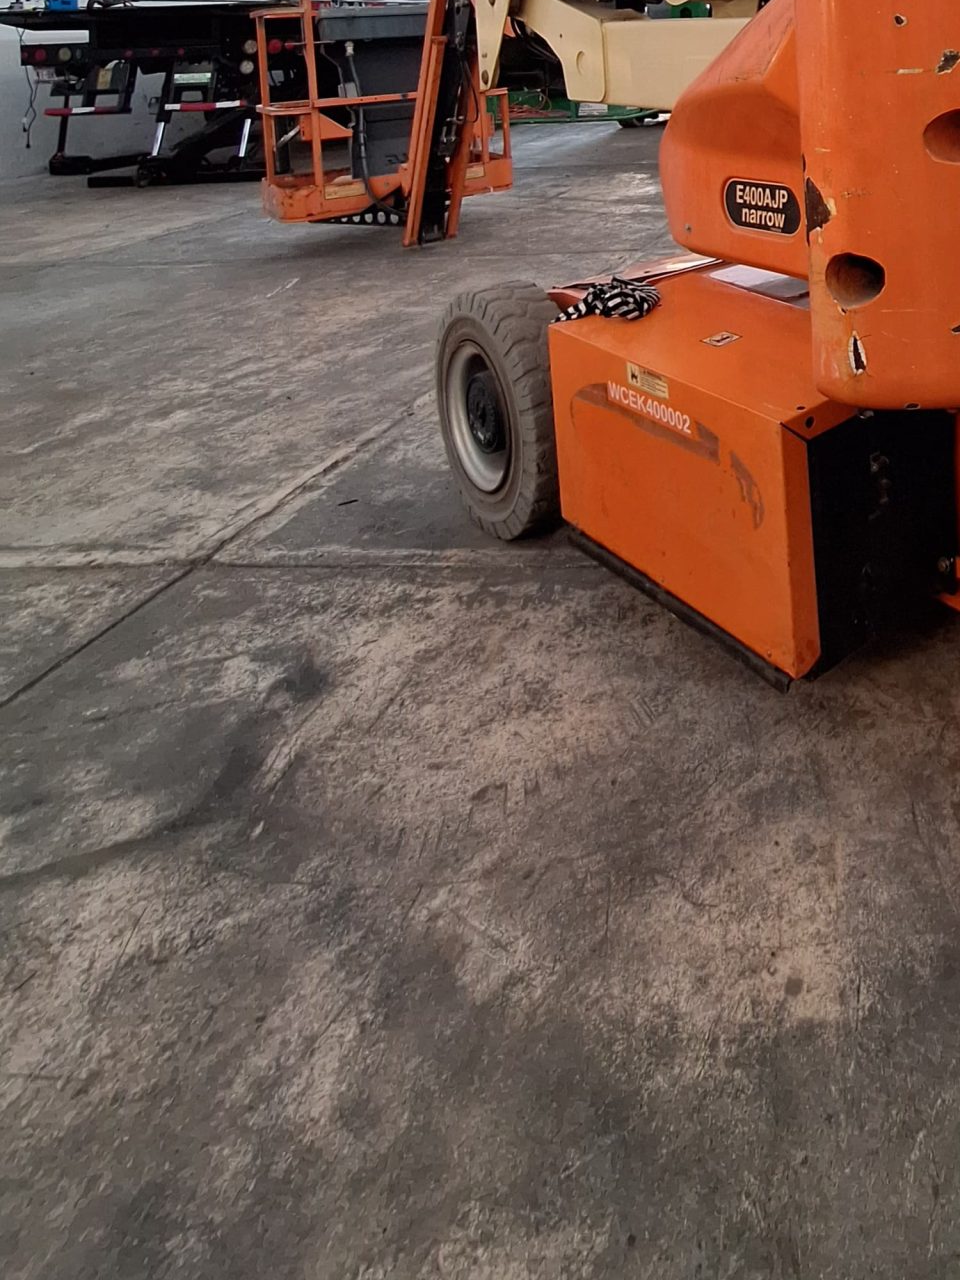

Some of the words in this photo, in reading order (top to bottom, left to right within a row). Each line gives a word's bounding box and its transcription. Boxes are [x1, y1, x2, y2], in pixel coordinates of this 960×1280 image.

[735, 184, 788, 209] E400AJP
[742, 207, 785, 228] narrow
[607, 380, 691, 434] WCEK400002
